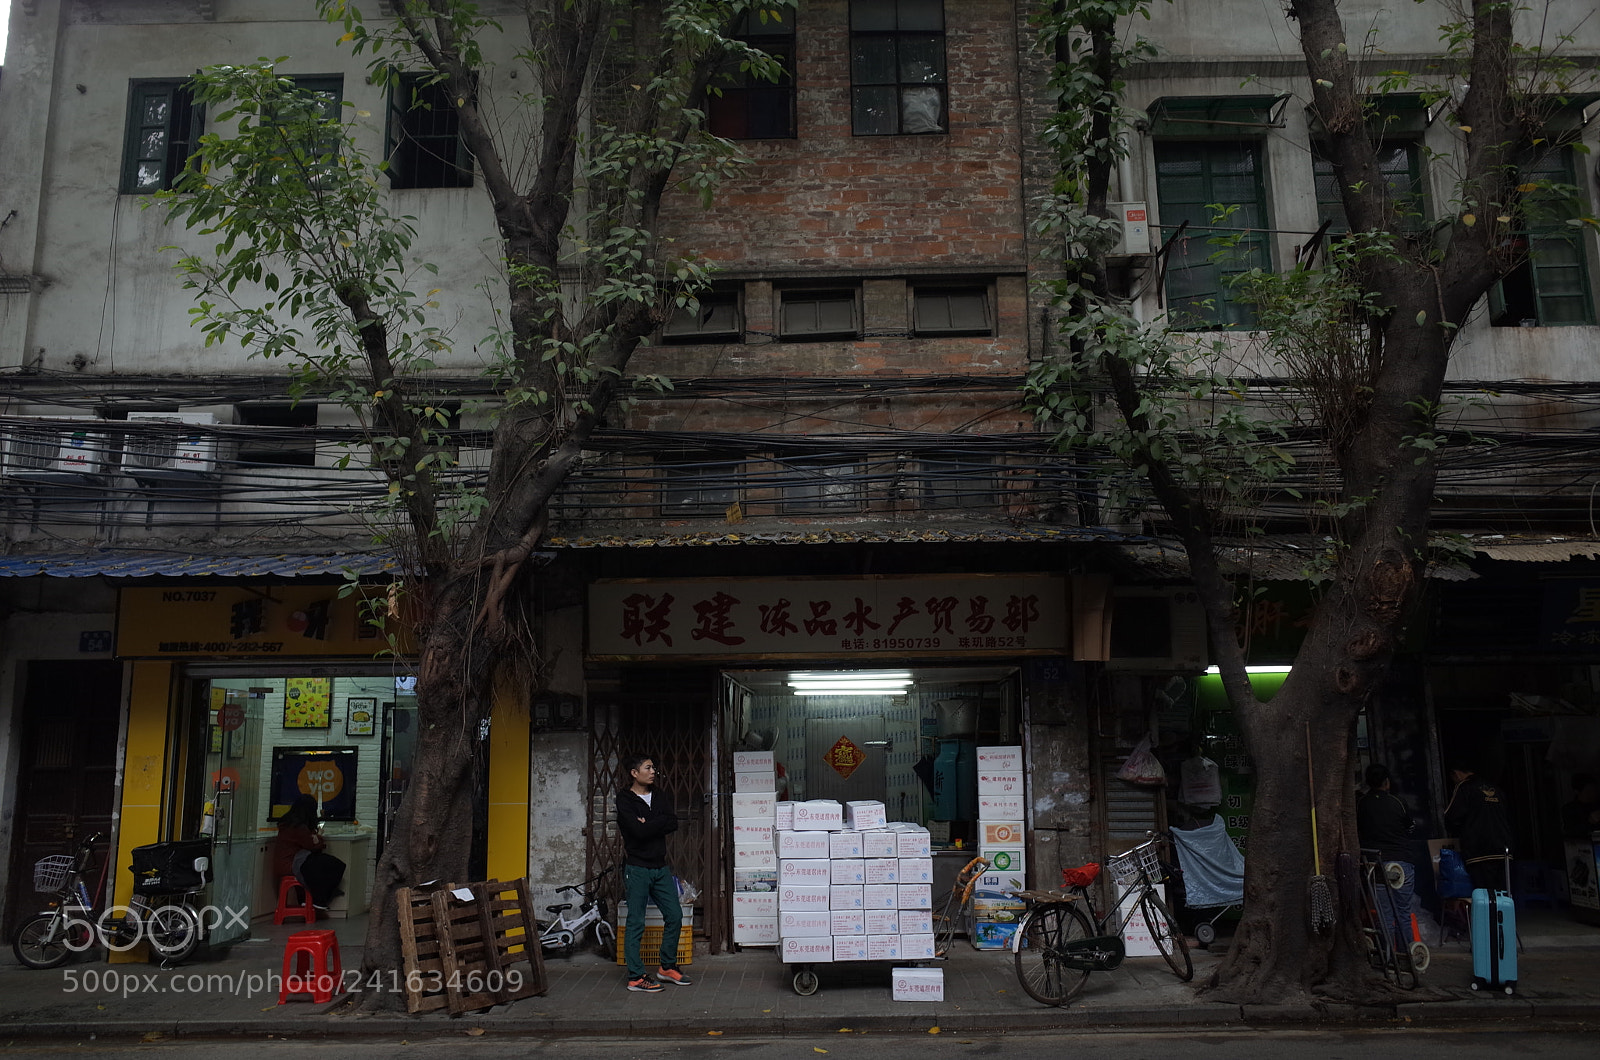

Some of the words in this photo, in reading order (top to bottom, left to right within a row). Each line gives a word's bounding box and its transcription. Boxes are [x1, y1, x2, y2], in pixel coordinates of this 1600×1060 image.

[162, 591, 216, 602] NO.7037
[619, 591, 1039, 648] 联建冻品水产贸易部
[1043, 667, 1059, 680] 52
